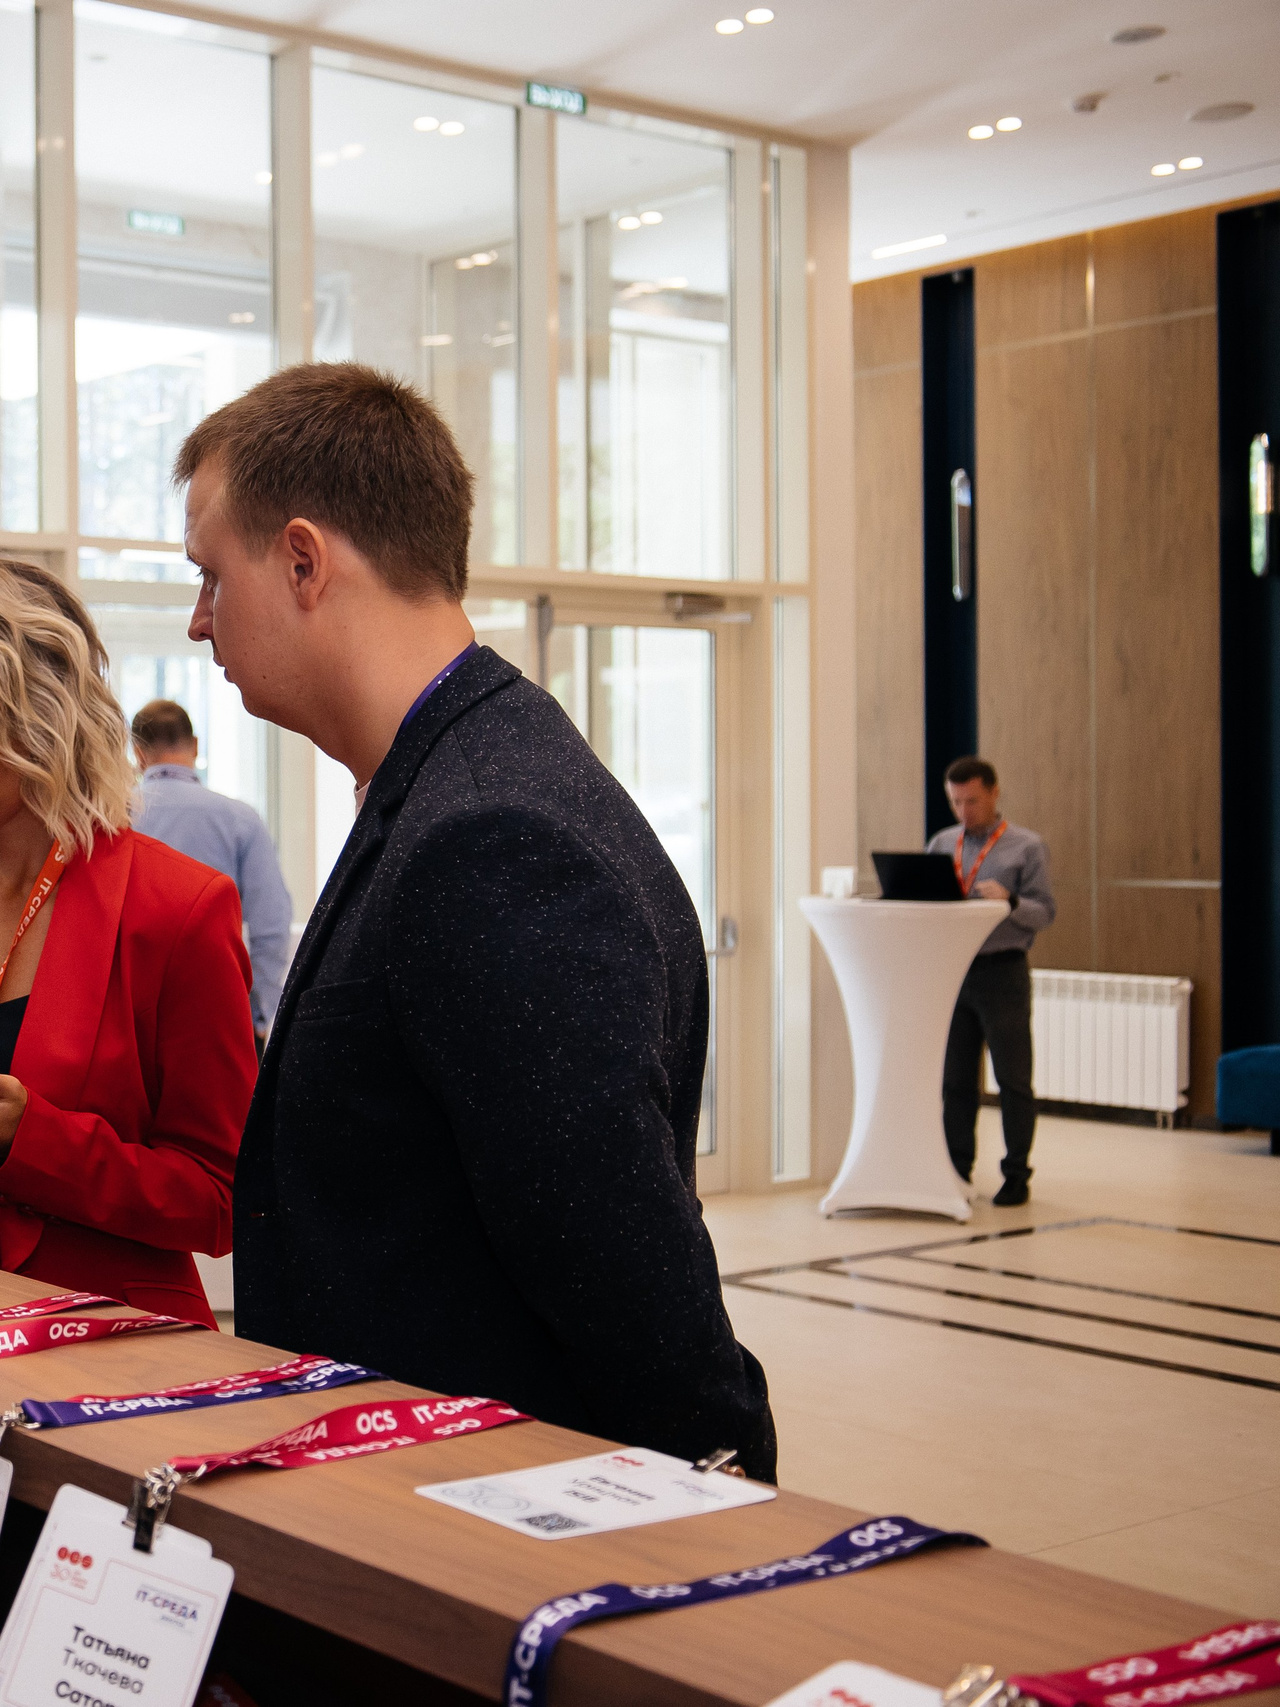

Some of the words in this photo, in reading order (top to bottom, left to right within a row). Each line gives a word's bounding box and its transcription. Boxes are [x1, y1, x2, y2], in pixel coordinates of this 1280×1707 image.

[48, 1322, 90, 1340] OCS
[79, 1396, 192, 1416] IT-СРЕДА
[214, 1386, 262, 1398] OCS
[356, 1408, 398, 1435] OCS
[433, 1418, 482, 1436] OCS
[304, 1435, 418, 1460] IT-СРЕДА
[848, 1518, 904, 1547] OCS
[136, 1589, 199, 1622] IT-СРЕДА
[72, 1624, 151, 1670] Татьяна
[63, 1648, 144, 1694] Ткачева
